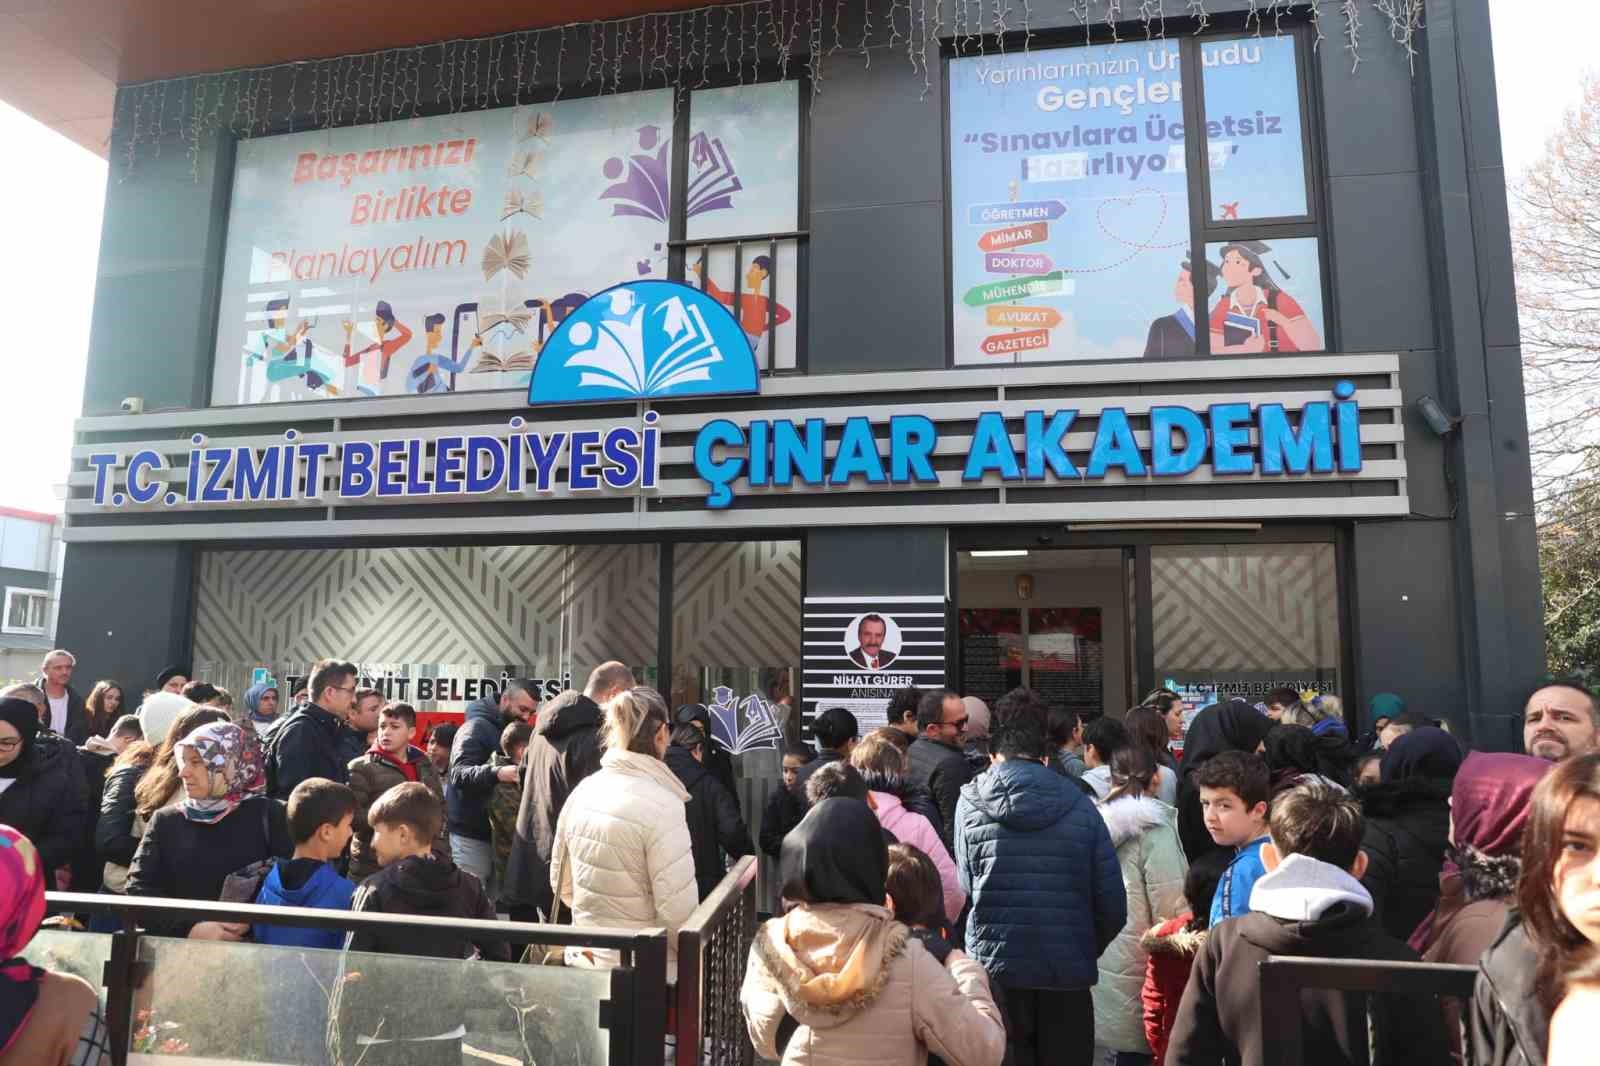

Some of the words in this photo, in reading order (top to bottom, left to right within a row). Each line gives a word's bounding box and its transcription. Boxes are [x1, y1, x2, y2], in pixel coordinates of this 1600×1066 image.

[1145, 110, 1282, 142] Ücetsiz
[350, 184, 473, 226] Birlikte
[981, 206, 1050, 222] ÖĞRETMEN
[990, 228, 1034, 246] MİMAR
[268, 236, 468, 284] Planlayalım
[991, 257, 1045, 269] DOKTOR
[997, 311, 1049, 323] AVUKAT
[985, 332, 1048, 352] GAZETECİ
[89, 448, 176, 506] T.C.
[185, 429, 330, 504] İZMİT
[338, 410, 661, 499] BELEDİYESİ
[693, 416, 940, 509] ÇINAR
[962, 379, 1364, 482] AKADEMİ
[833, 674, 868, 687] NİHAT
[872, 673, 913, 687] GÜRER
